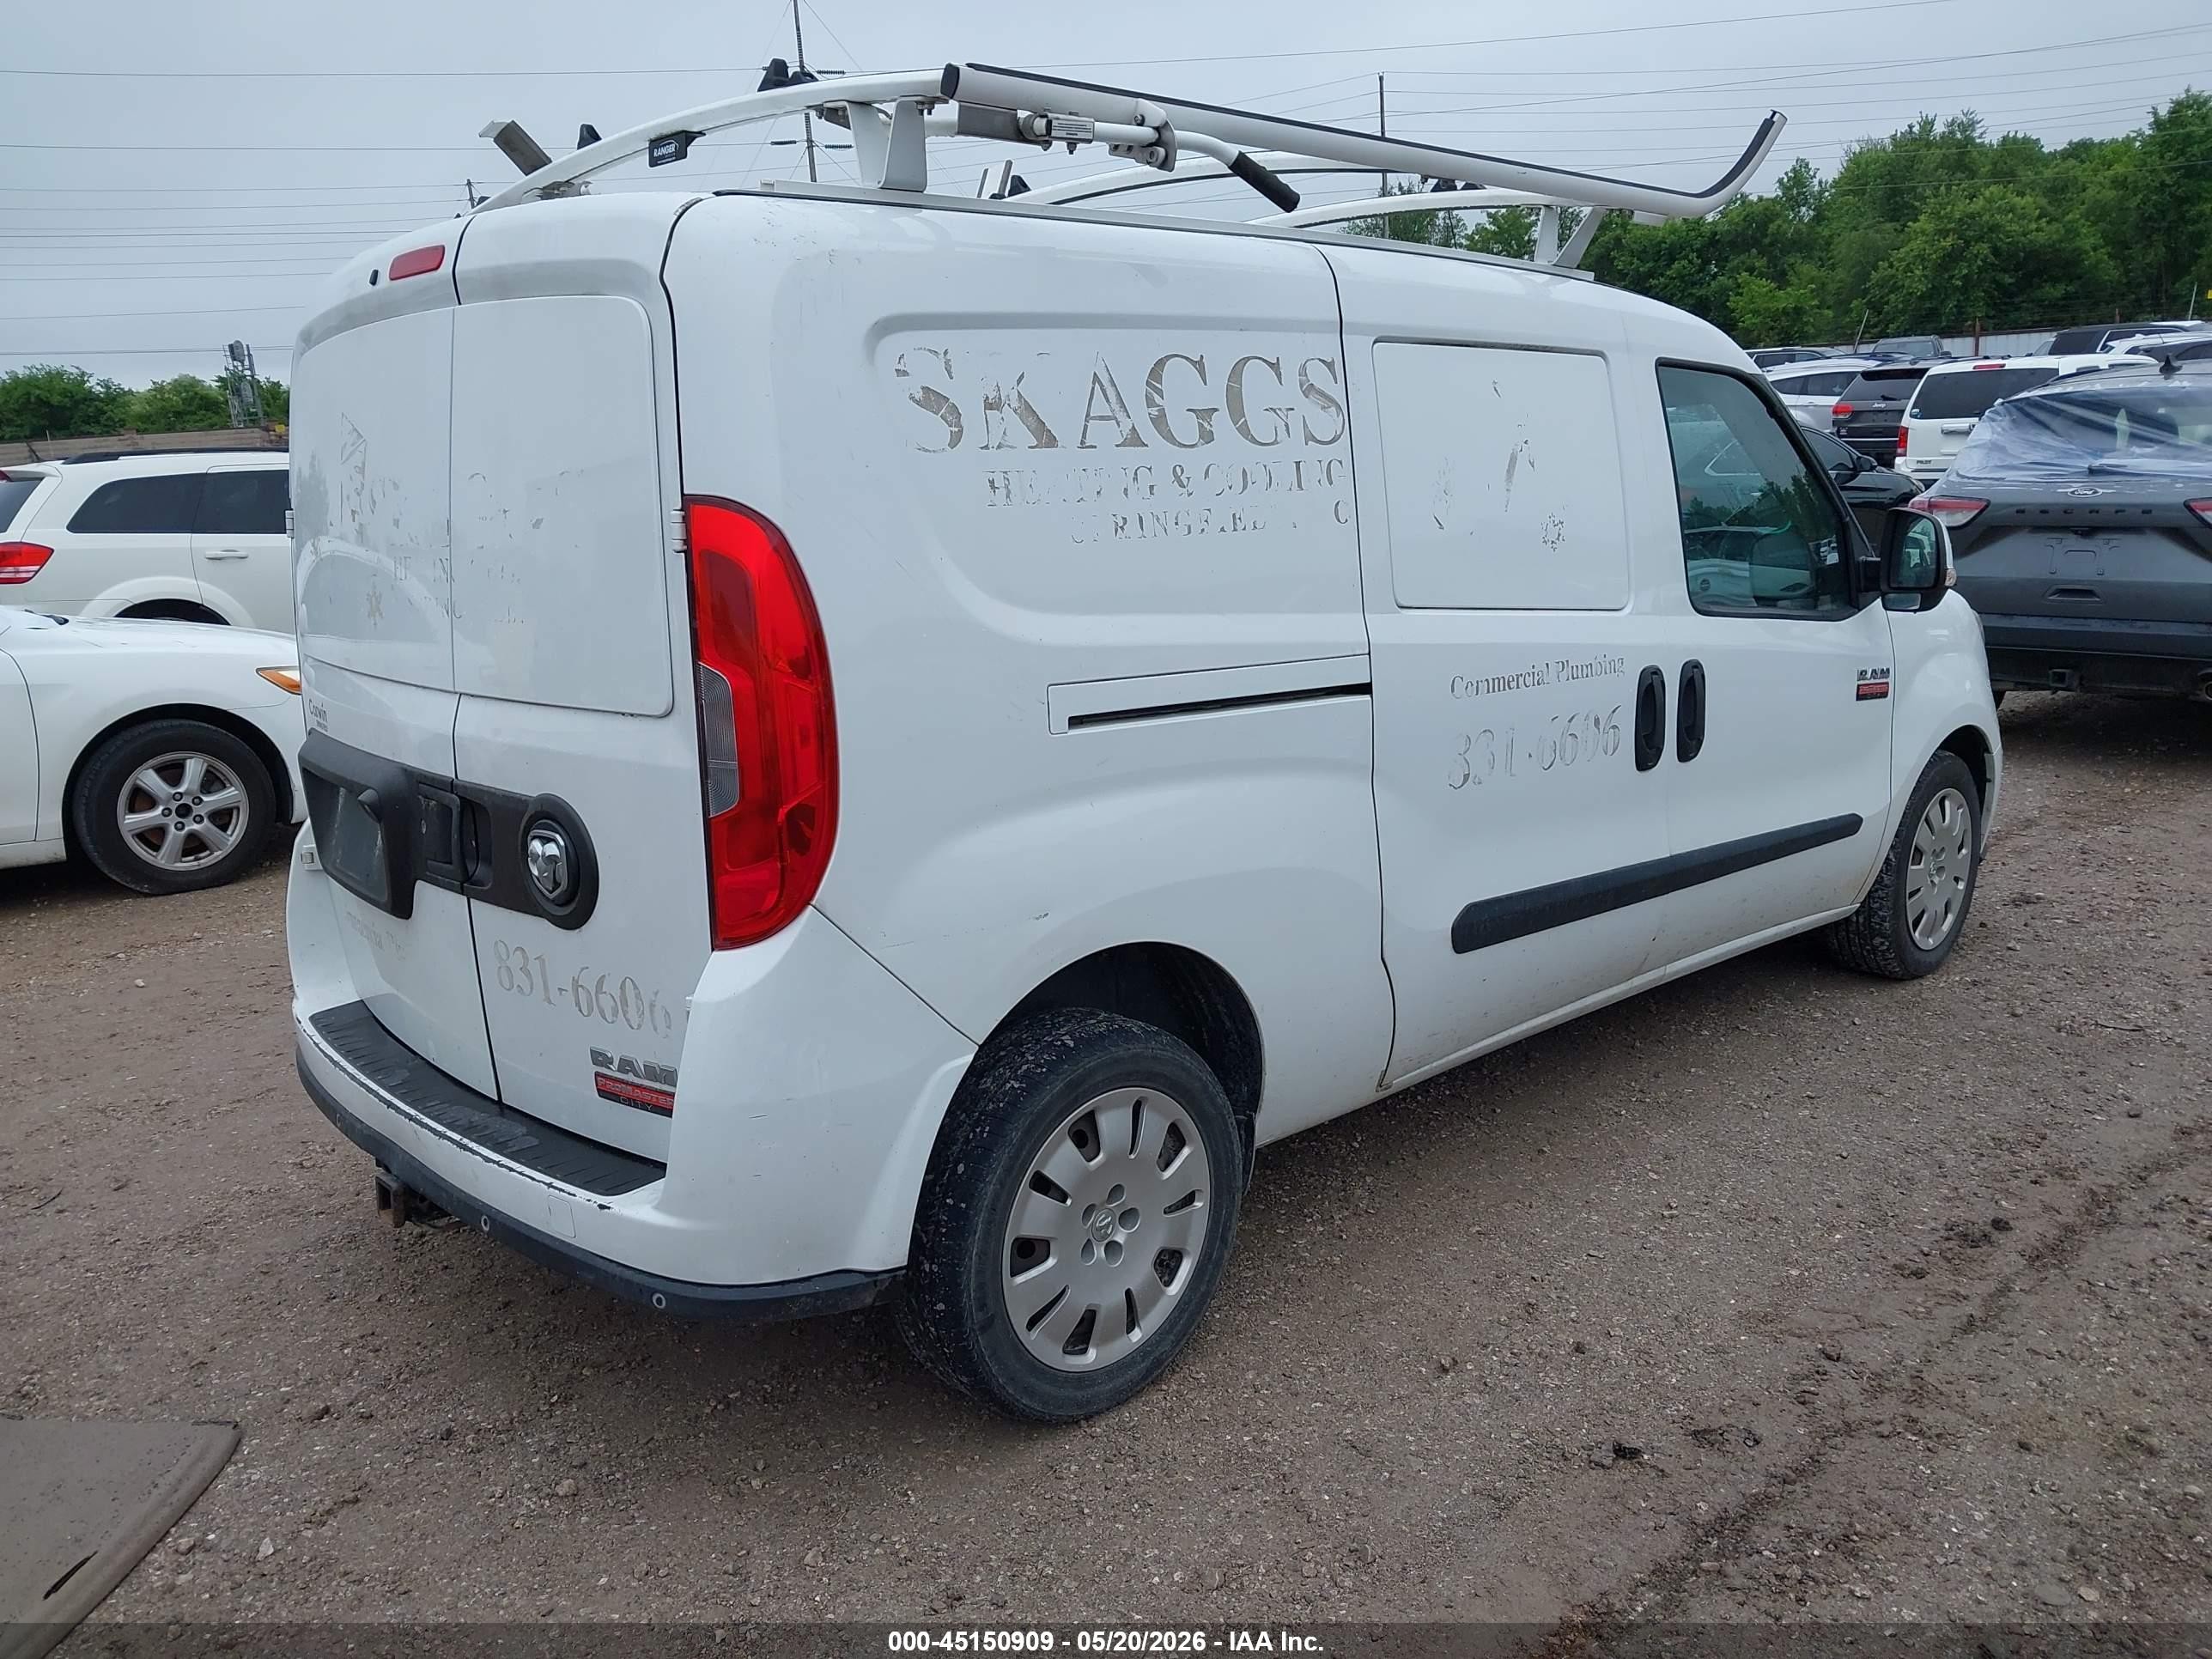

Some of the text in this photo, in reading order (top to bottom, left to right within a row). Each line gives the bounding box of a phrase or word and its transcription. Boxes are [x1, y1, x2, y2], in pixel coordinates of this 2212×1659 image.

[653, 143, 677, 157] RANGER
[894, 346, 1346, 453] SKAGGS
[981, 465, 1158, 507] HETING
[1171, 464, 1194, 498] &
[1450, 653, 1626, 700] Commercial Plumbing
[1856, 667, 1891, 681] RAM
[493, 939, 672, 1039] 831-6606
[589, 1045, 678, 1088] RAM
[619, 1096, 653, 1111] CITY
